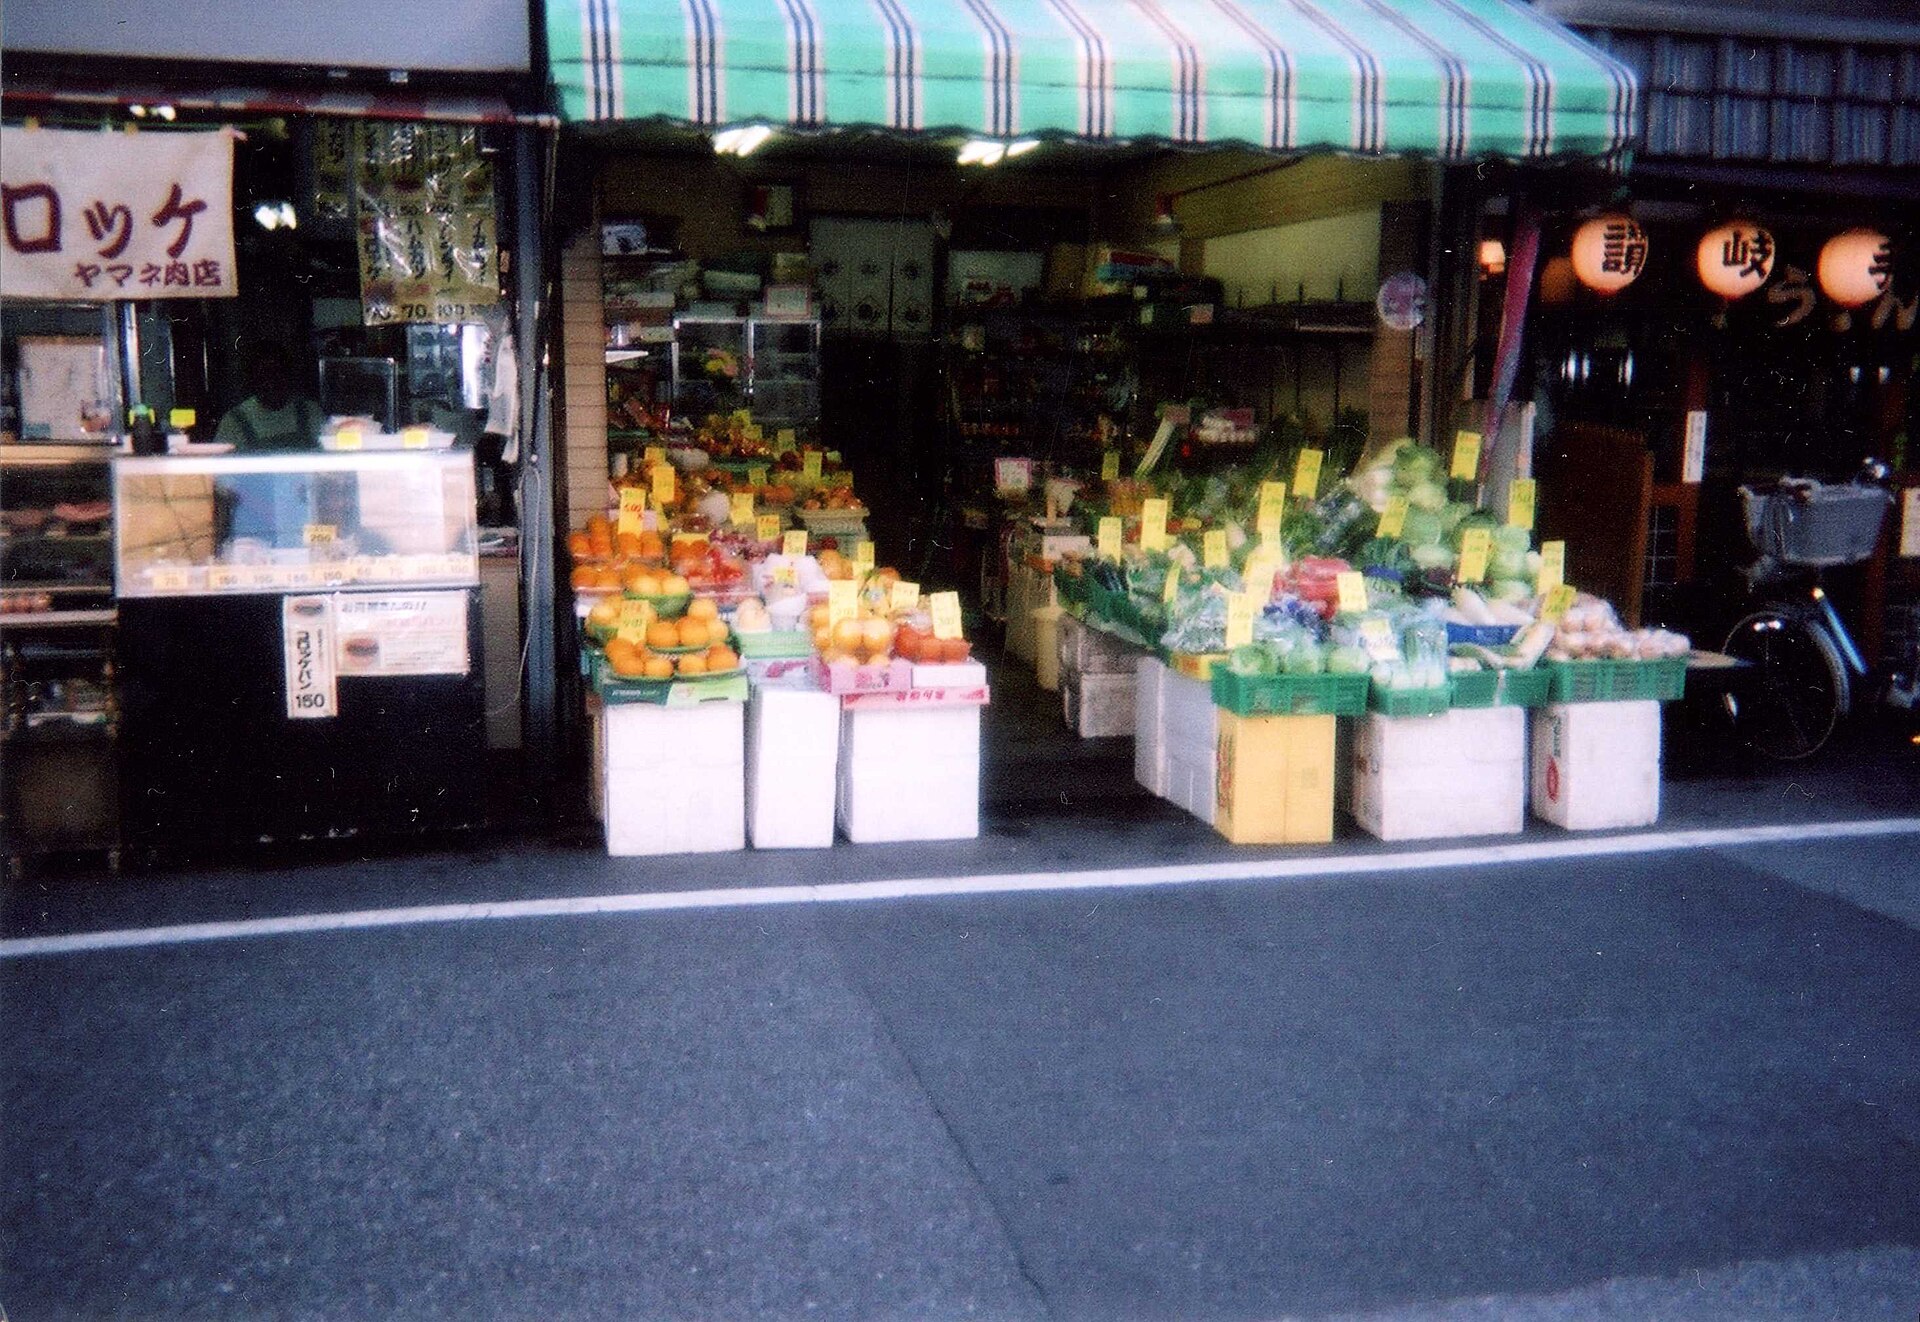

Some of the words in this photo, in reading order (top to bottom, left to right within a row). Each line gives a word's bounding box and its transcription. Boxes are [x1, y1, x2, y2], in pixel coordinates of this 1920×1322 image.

[1, 182, 207, 259] ロッケ
[75, 258, 221, 288] ヤマネ肉店
[295, 693, 326, 709] 150
